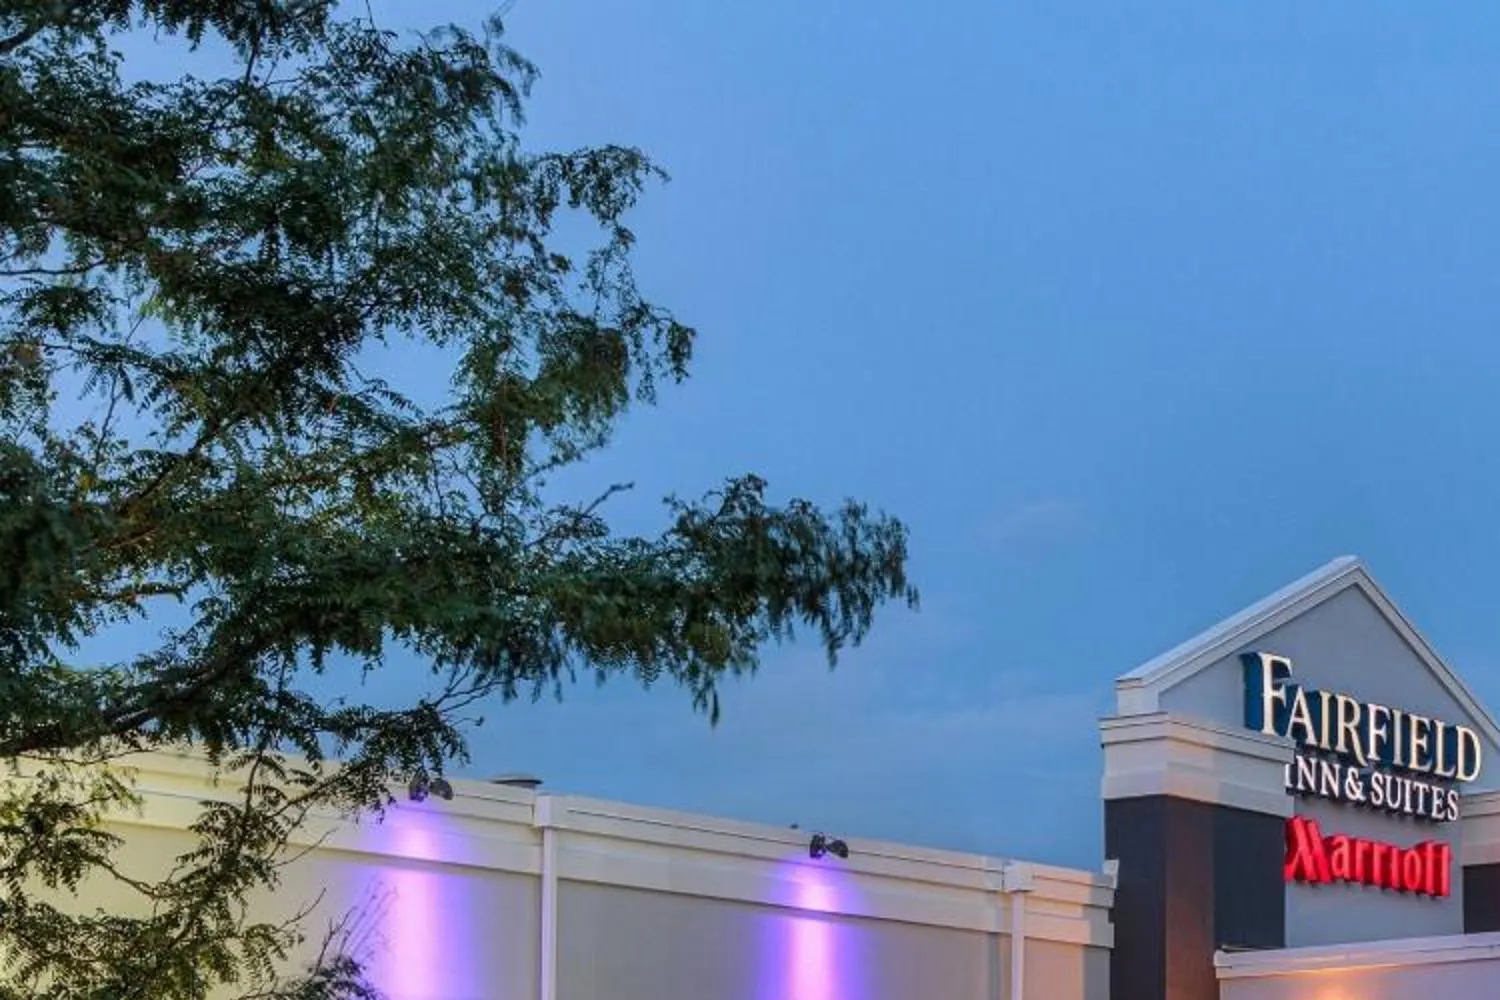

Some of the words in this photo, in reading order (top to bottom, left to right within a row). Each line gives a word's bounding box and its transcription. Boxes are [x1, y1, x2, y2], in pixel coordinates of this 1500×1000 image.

[1247, 651, 1482, 783] FAIRFIELD
[1284, 754, 1342, 799] INN
[1345, 766, 1367, 802] &
[1370, 771, 1460, 822] SUITES
[1284, 815, 1453, 897] Marriott
